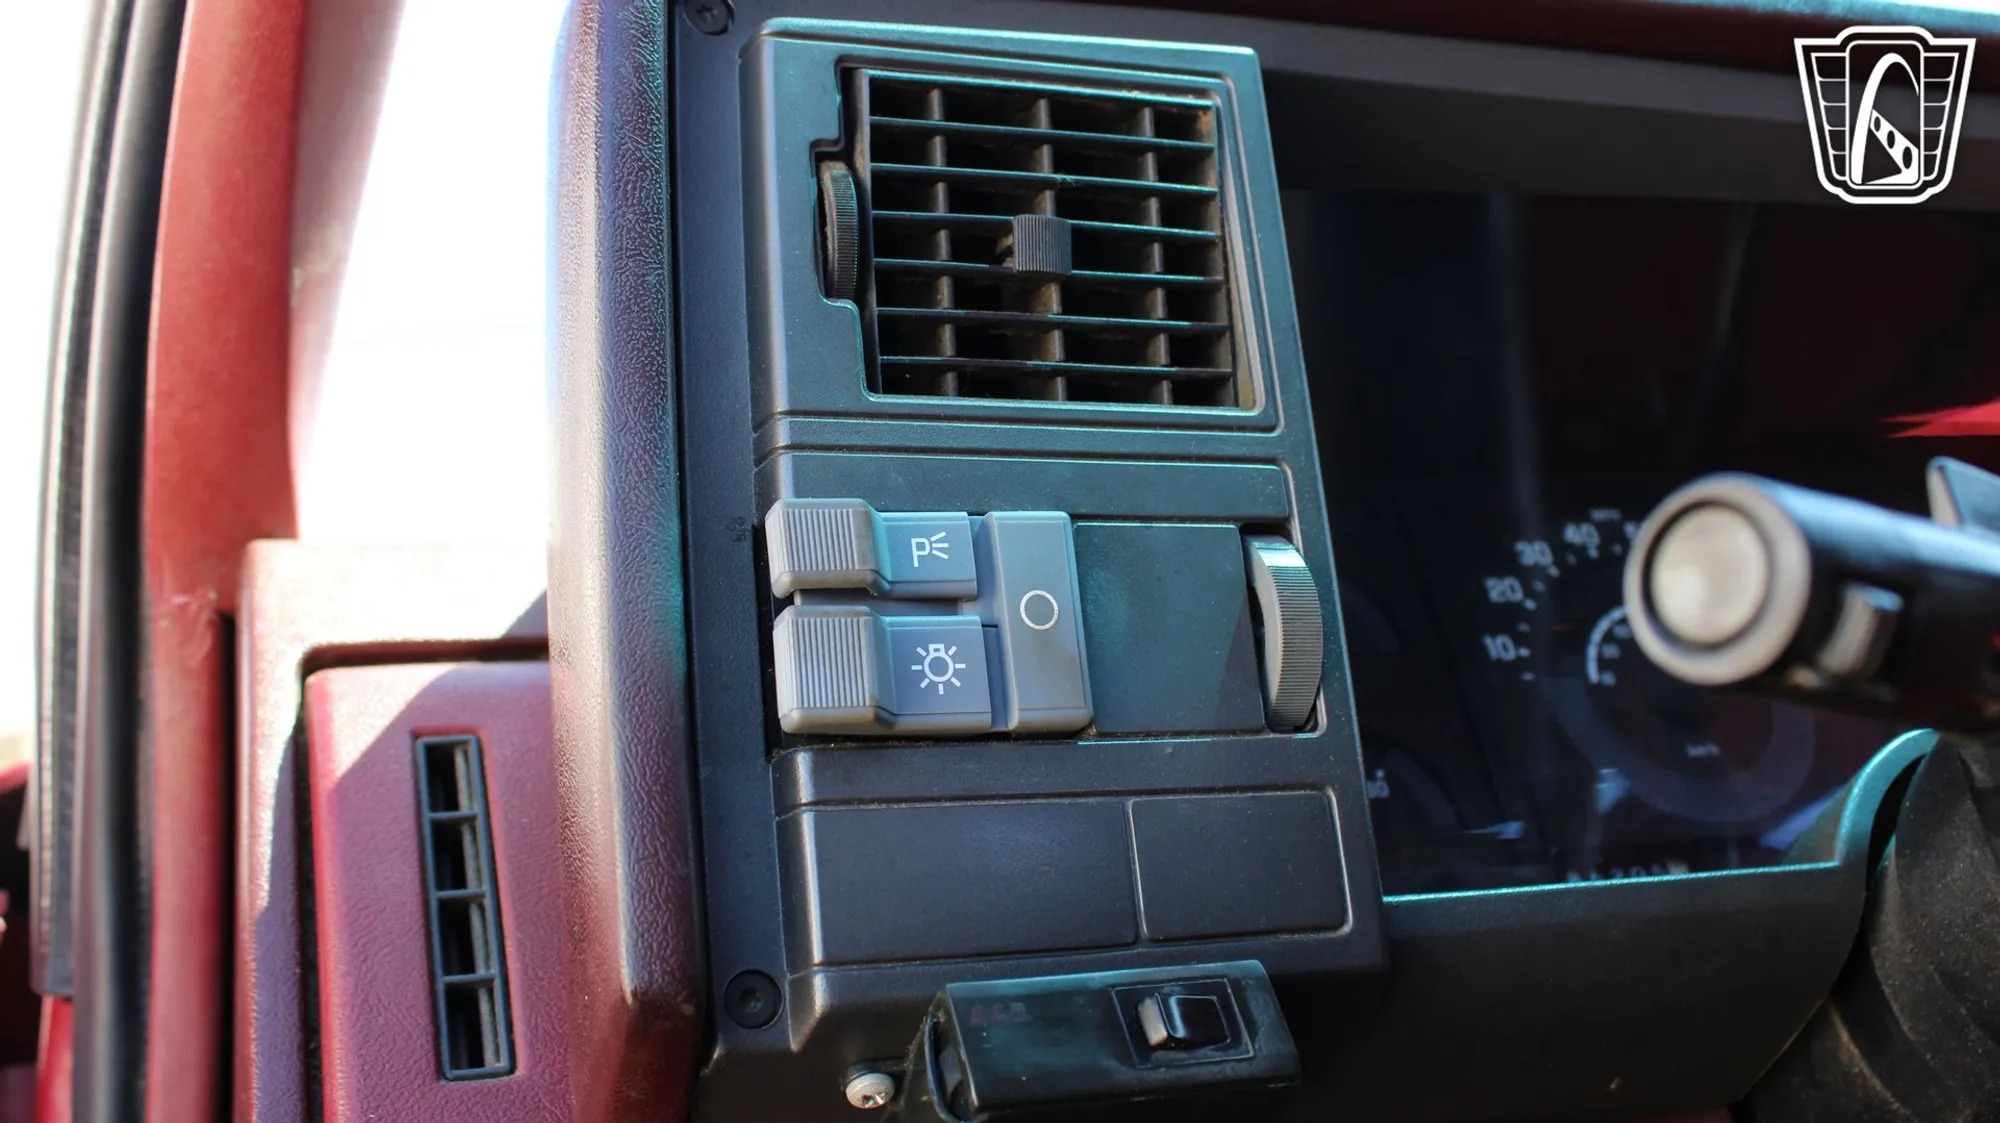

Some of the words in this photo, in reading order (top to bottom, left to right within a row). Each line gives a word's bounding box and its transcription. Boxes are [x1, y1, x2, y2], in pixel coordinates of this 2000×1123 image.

[1563, 521, 1600, 546] 40
[1513, 540, 1554, 566] 30
[1483, 576, 1524, 603] 20
[1482, 635, 1516, 661] 10
